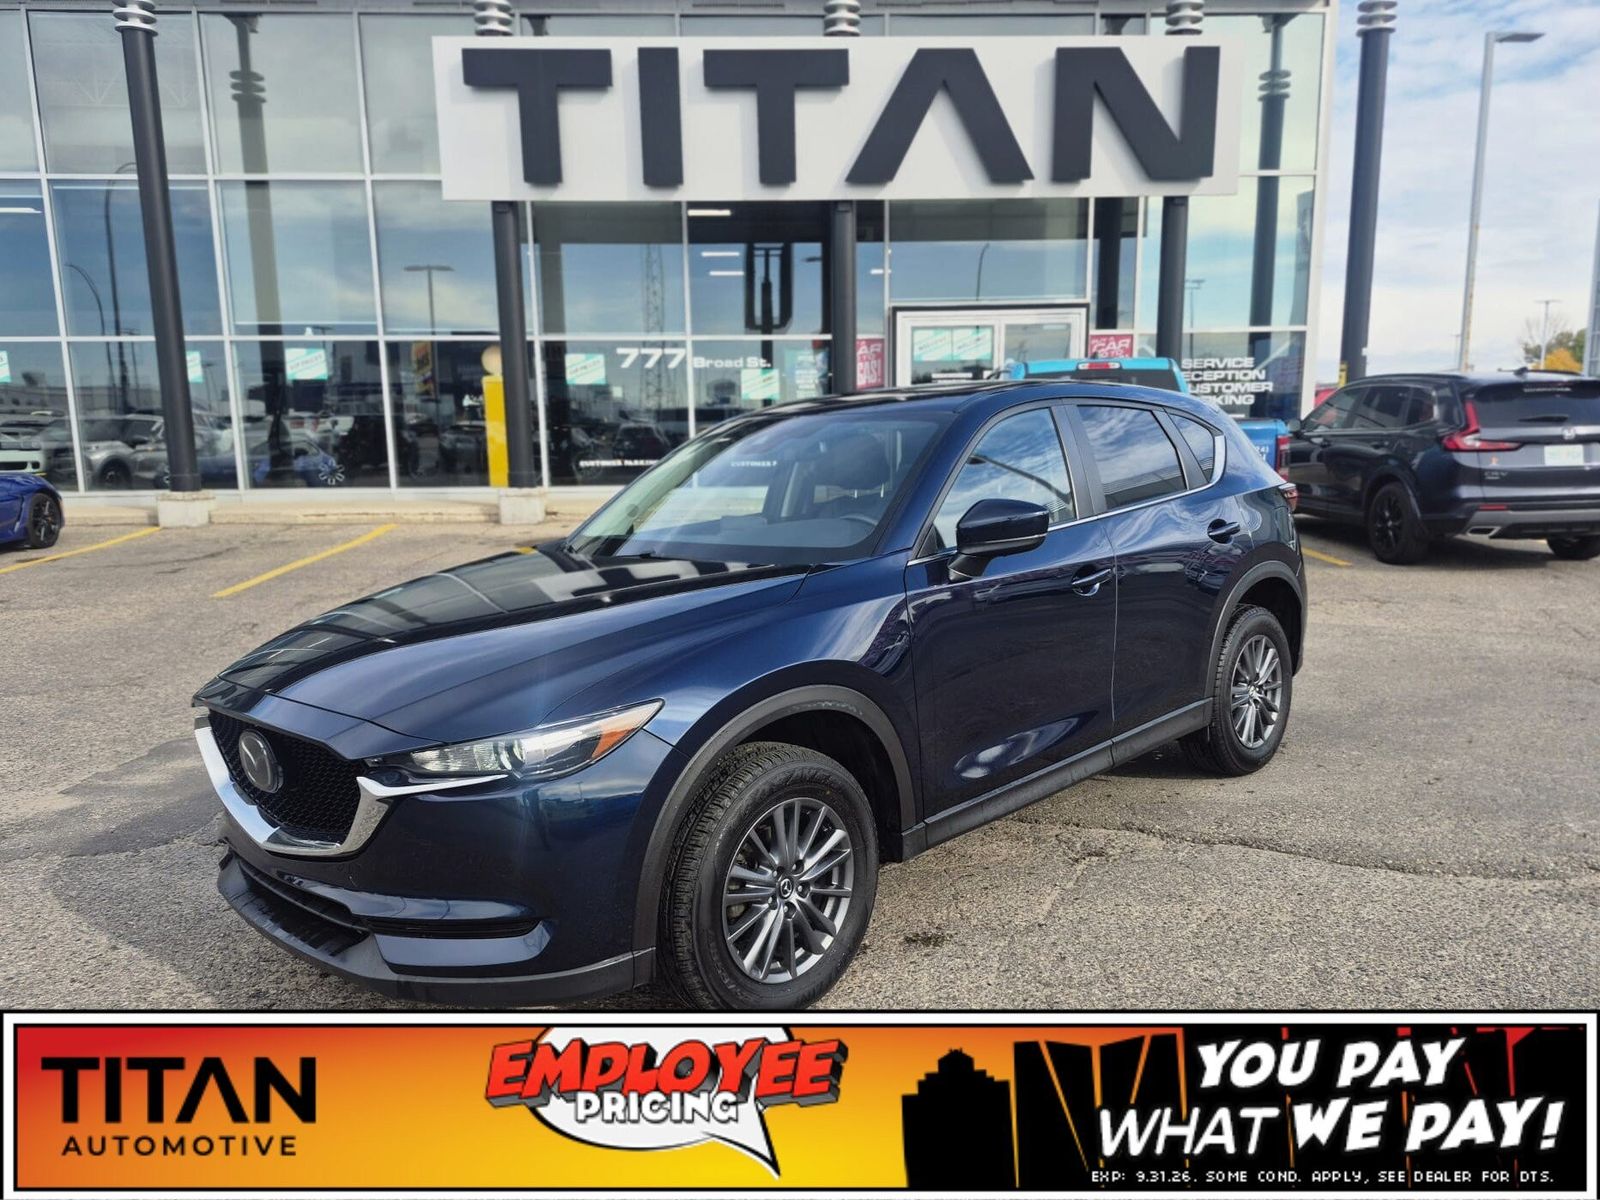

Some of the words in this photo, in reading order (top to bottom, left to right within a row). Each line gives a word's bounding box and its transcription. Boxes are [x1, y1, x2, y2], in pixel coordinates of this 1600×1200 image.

[461, 46, 1221, 187] TITAN
[616, 348, 686, 368] 777
[693, 356, 744, 368] Broad
[747, 356, 772, 368] St.
[1181, 357, 1255, 369] SERVICE
[1183, 369, 1266, 382] ECEPTION
[1188, 382, 1274, 394] USTOMER
[1202, 394, 1255, 406] RKING
